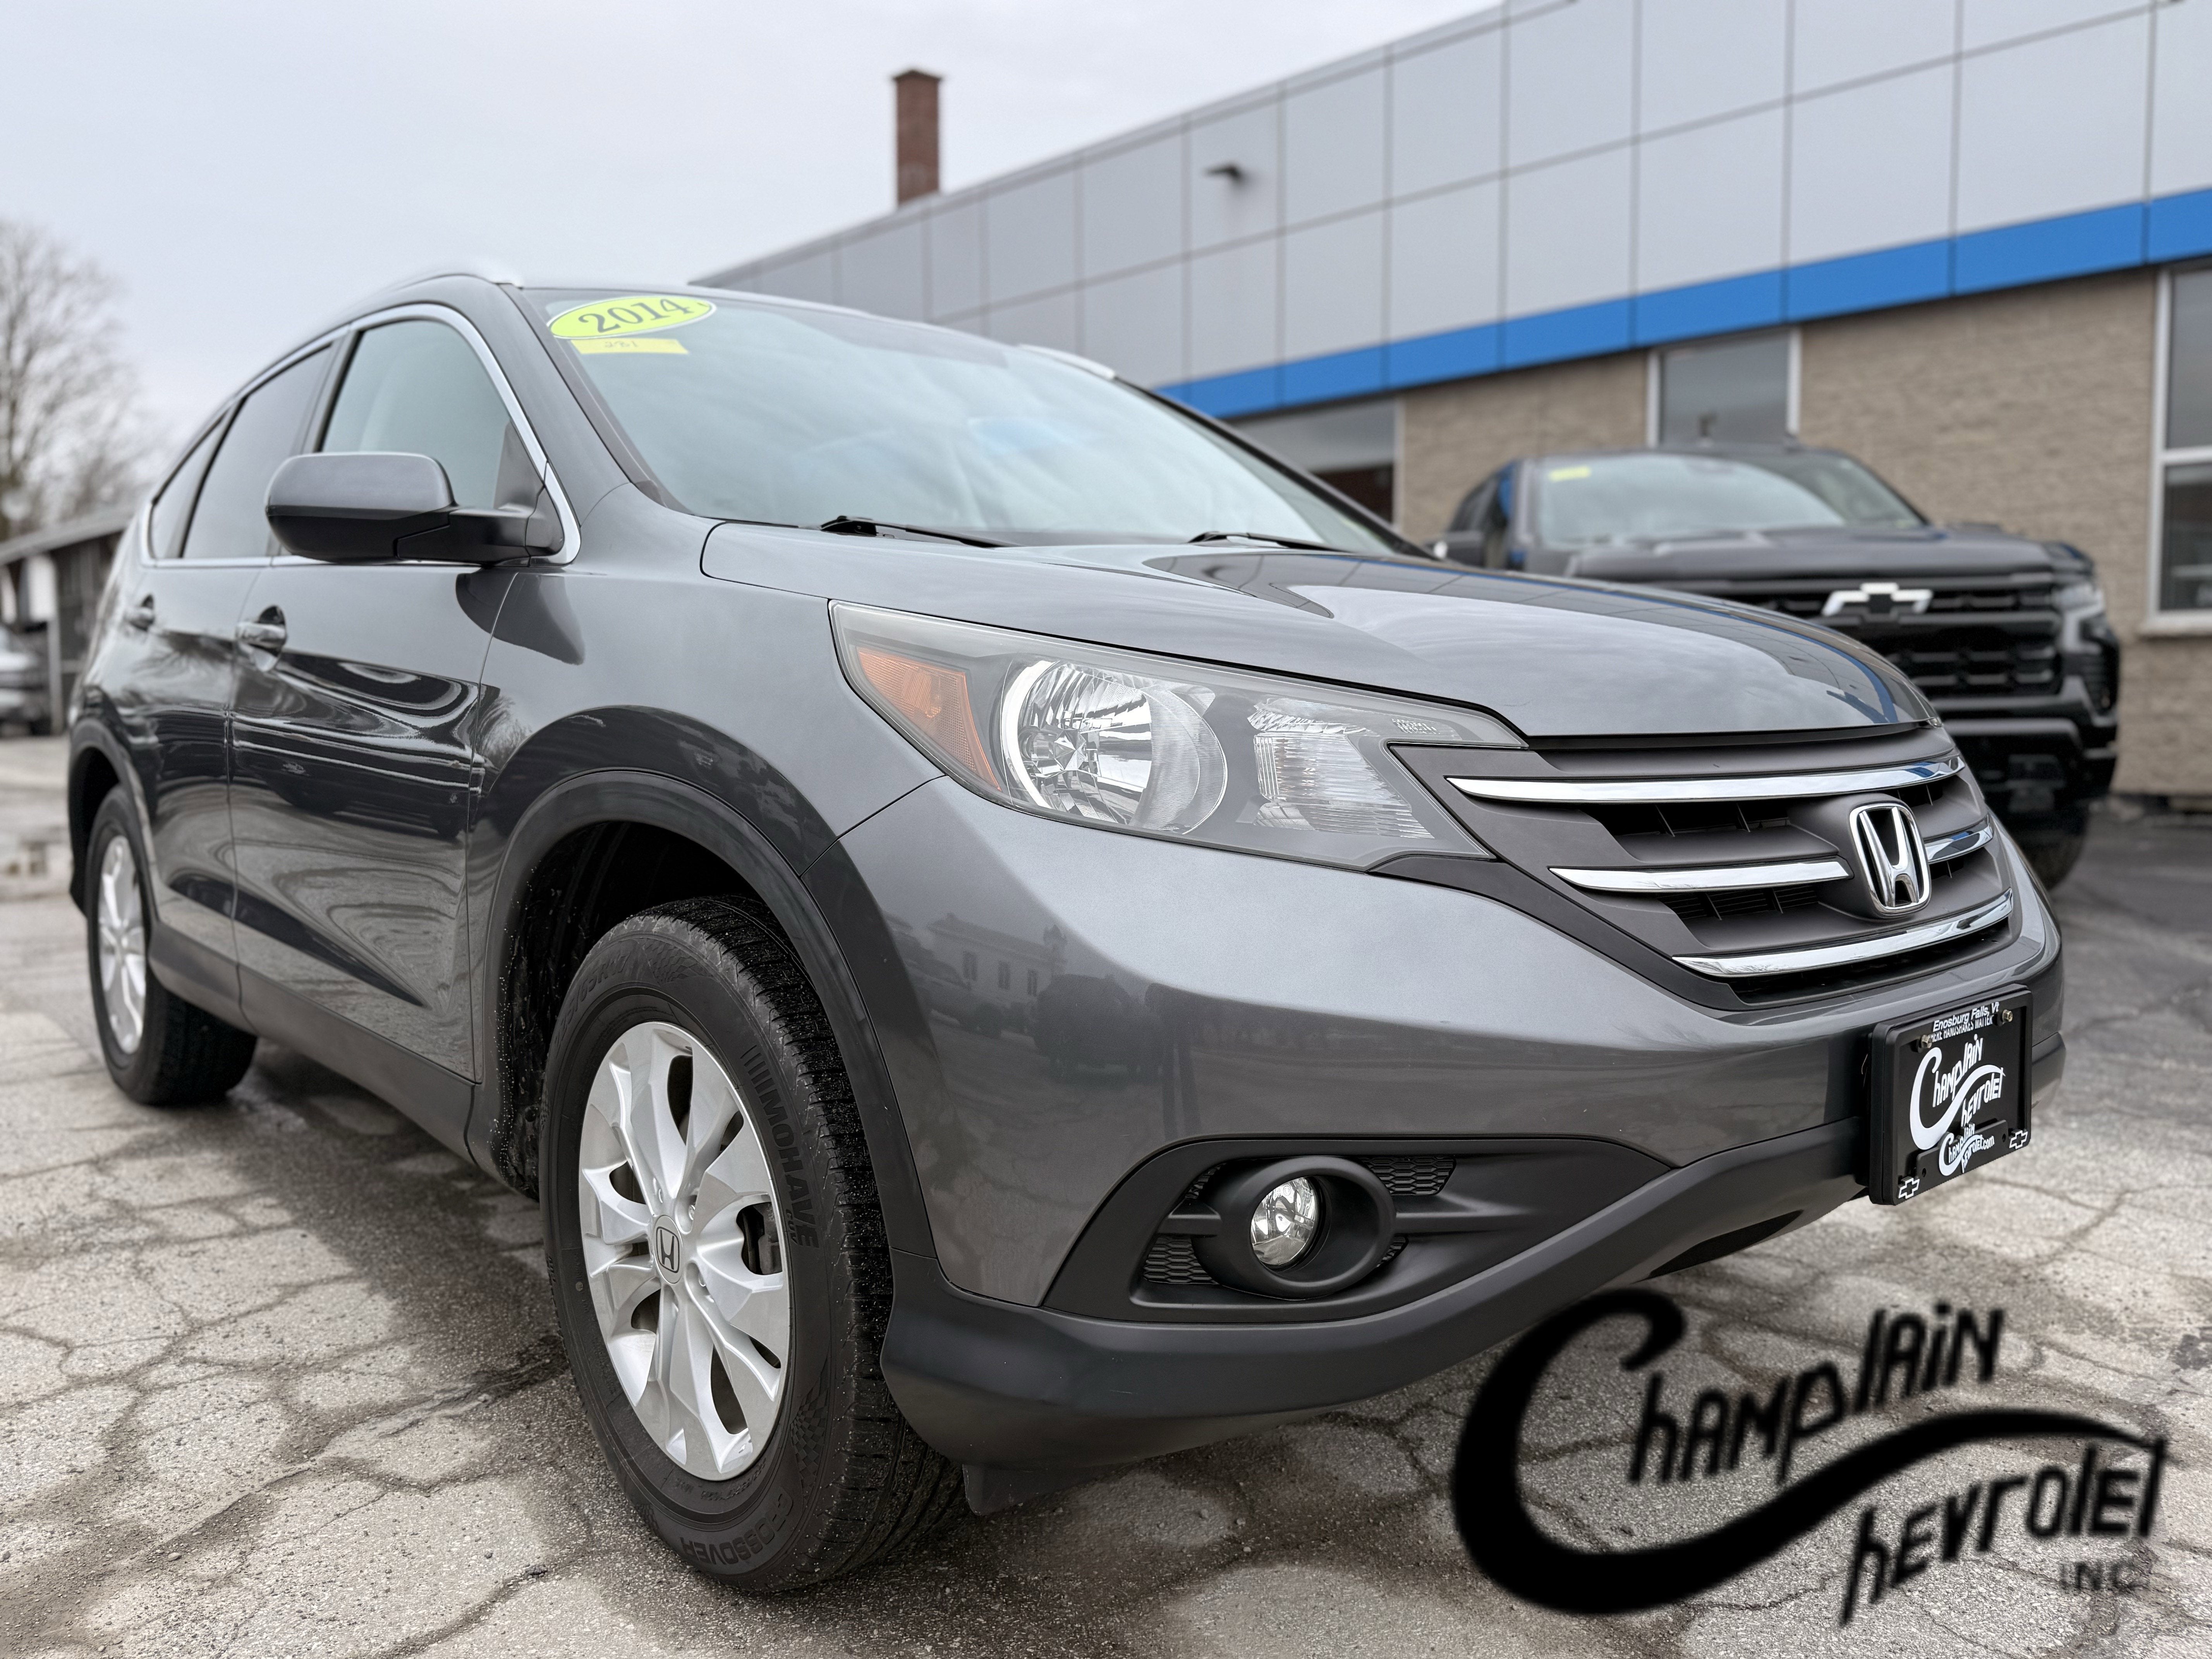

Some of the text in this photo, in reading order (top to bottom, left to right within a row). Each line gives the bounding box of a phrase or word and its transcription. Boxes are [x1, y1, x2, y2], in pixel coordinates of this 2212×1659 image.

[578, 299, 695, 333] 2014
[1932, 1012, 1970, 1032] Enosburg
[759, 1089, 820, 1248] MOHAVE
